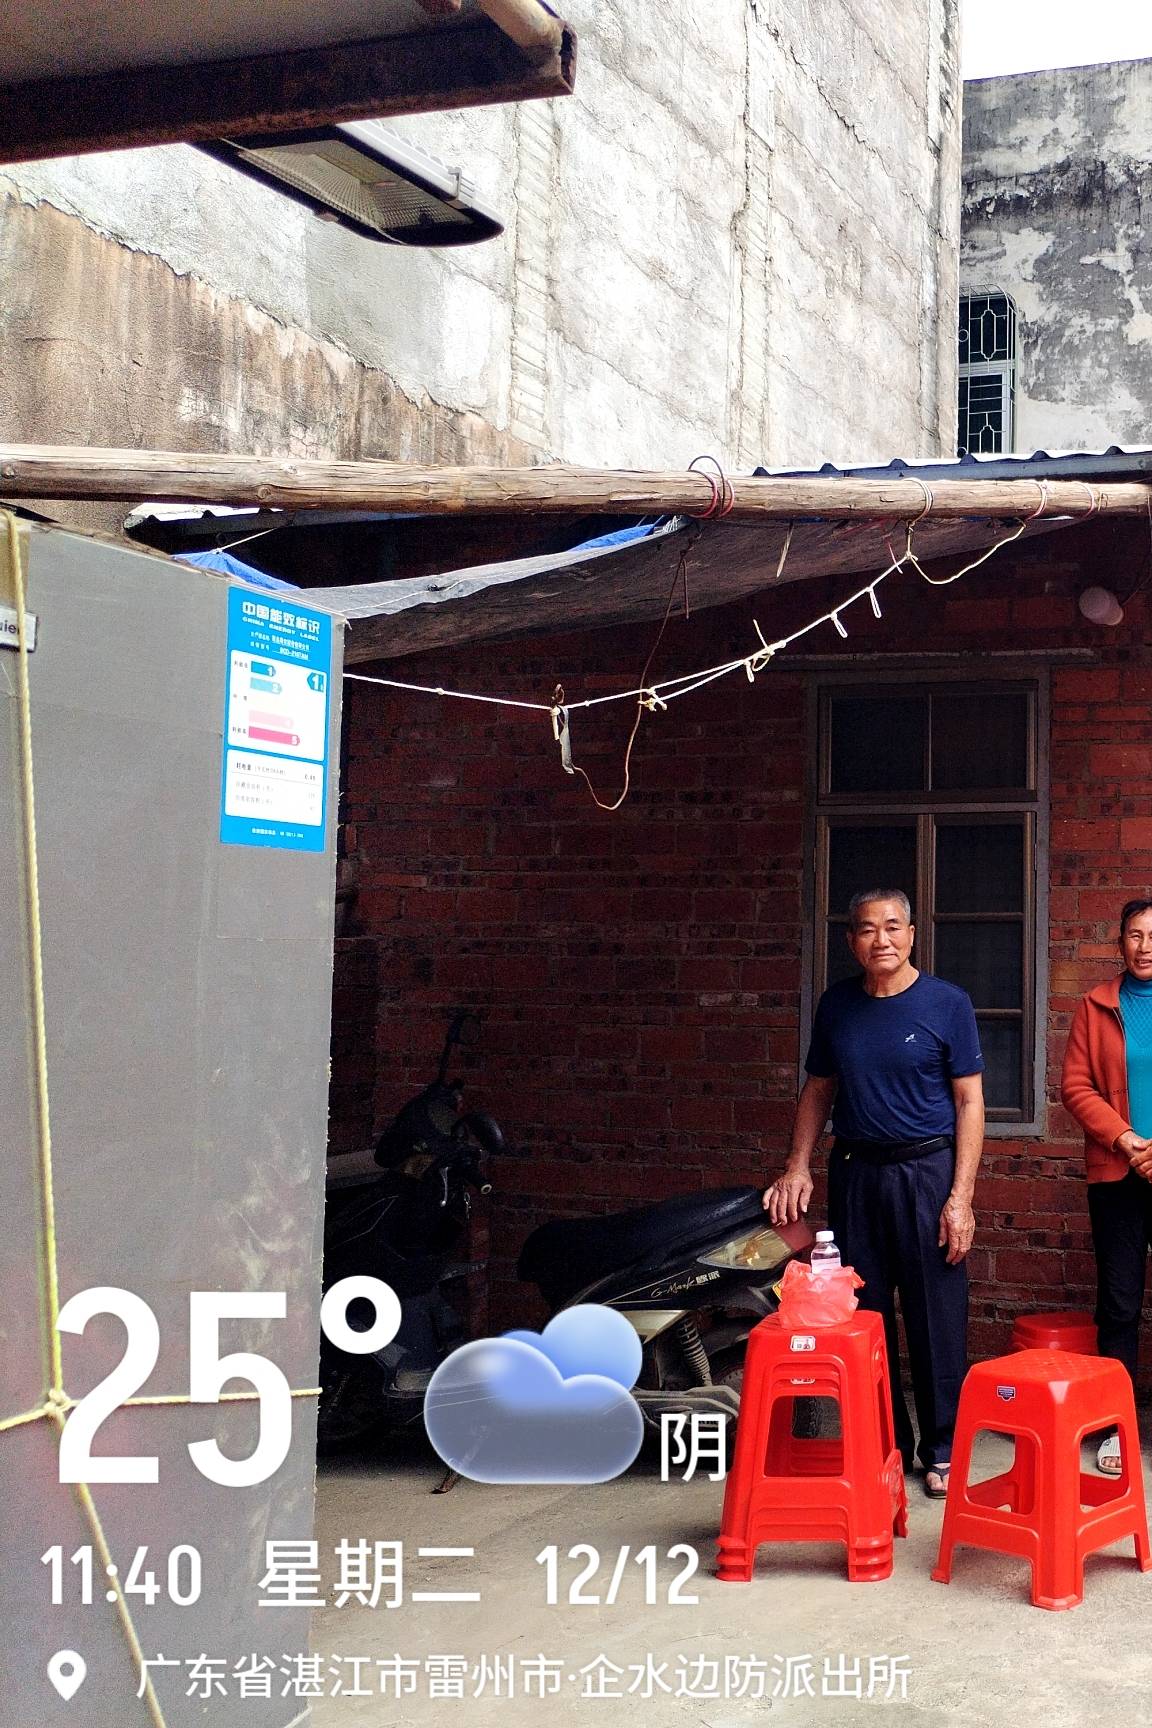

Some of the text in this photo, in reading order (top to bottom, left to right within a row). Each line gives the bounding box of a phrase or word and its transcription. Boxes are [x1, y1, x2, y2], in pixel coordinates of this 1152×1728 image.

[242, 601, 320, 634] 中国能效标识
